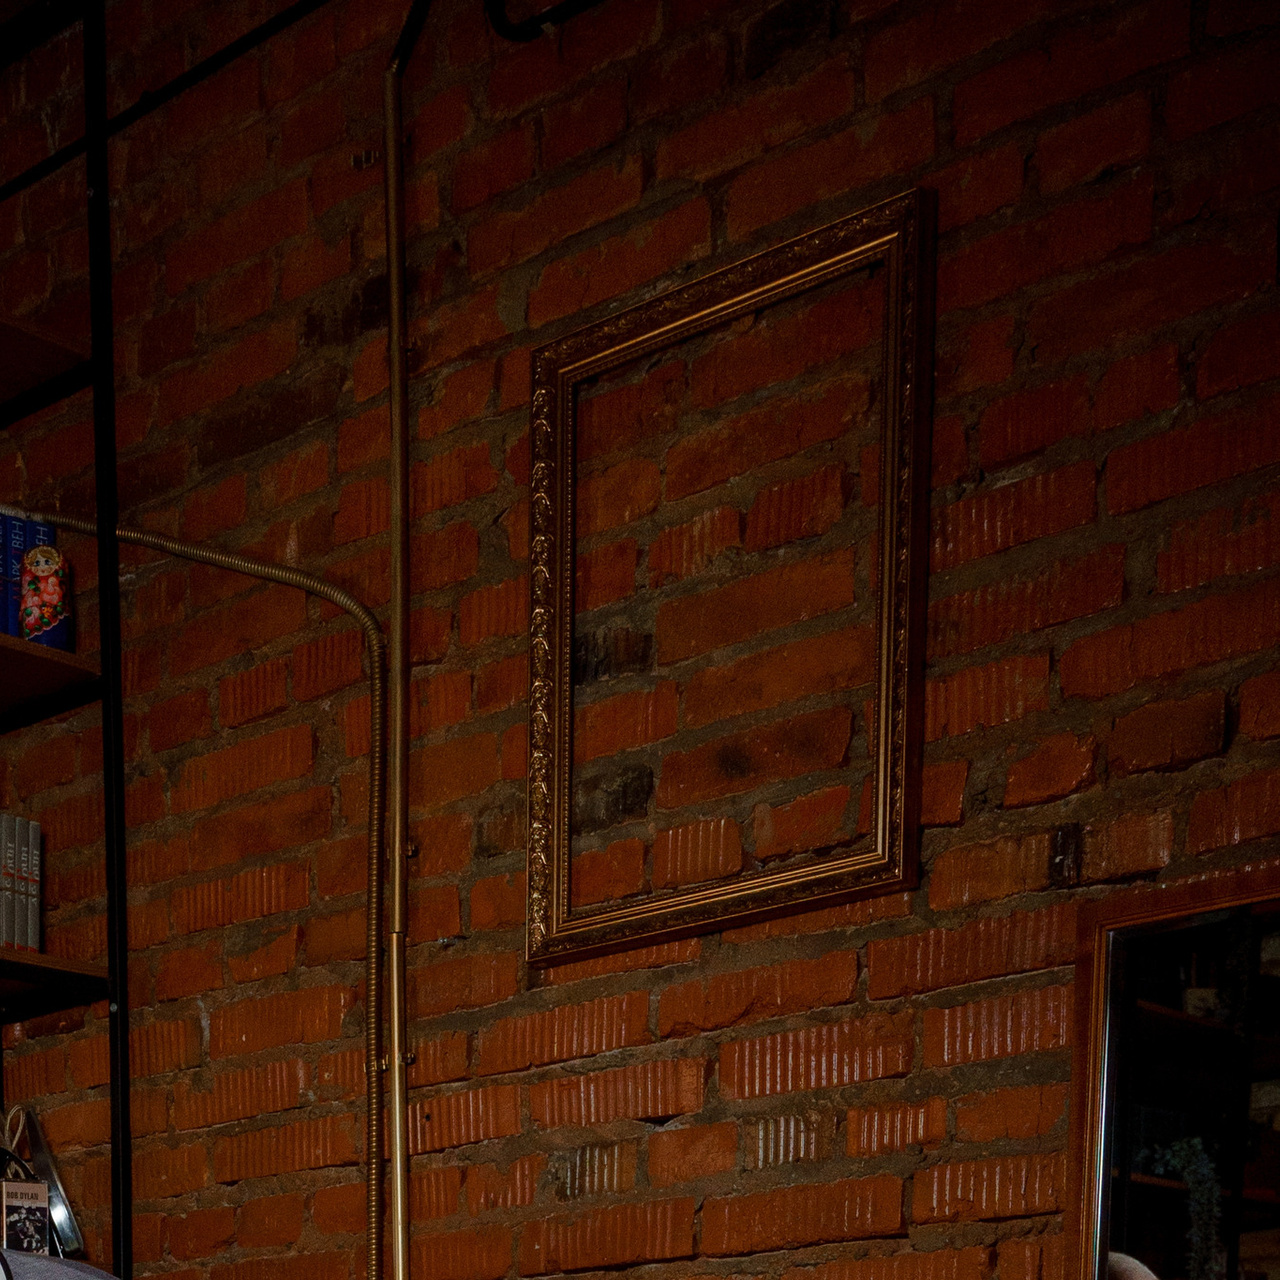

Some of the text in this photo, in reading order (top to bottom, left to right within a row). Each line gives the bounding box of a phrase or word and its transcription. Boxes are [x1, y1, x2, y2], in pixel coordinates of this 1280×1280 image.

[11, 520, 24, 556] ТВЕН
[6, 1191, 39, 1200] BOB DYLAN
